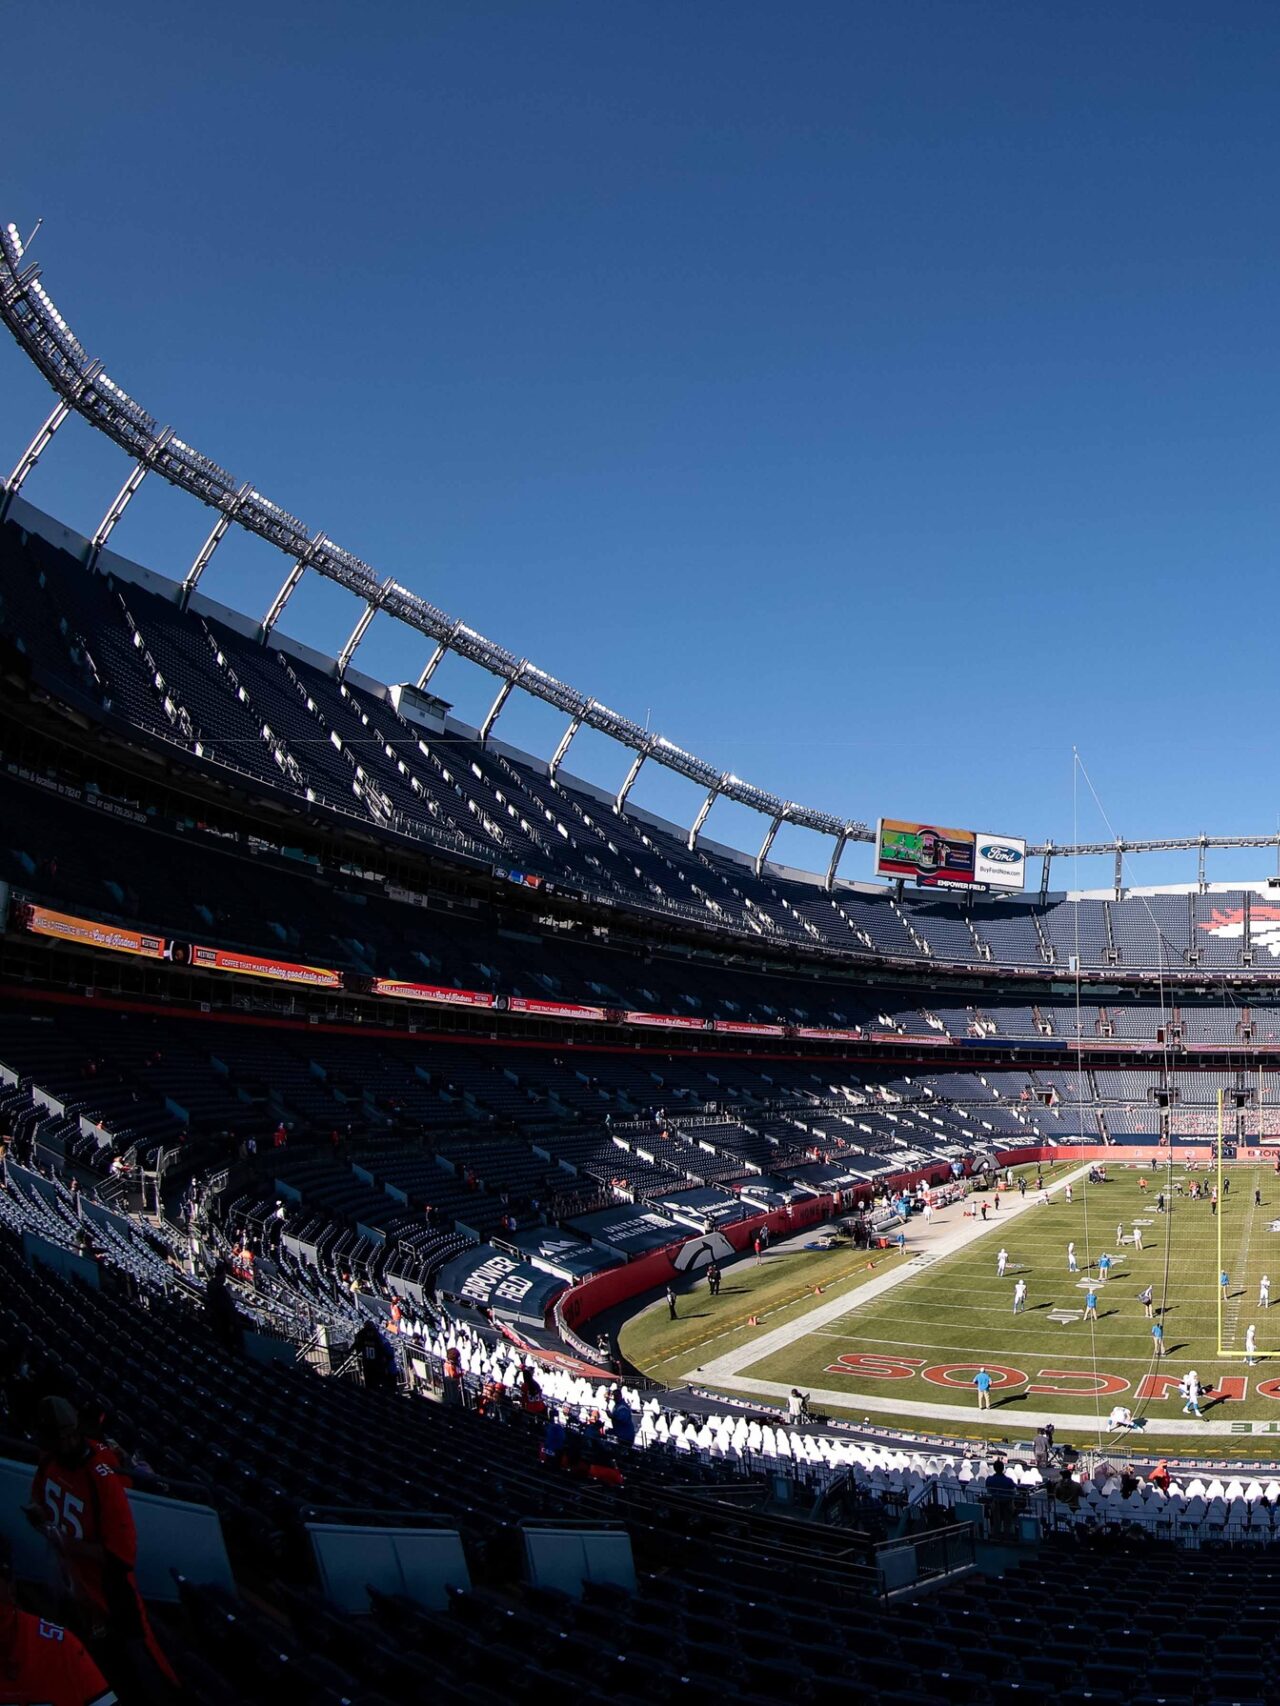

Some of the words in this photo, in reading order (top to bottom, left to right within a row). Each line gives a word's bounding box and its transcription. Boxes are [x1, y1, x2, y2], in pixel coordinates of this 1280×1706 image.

[986, 846, 1016, 862] Ford
[937, 879, 969, 890] EMPOWER
[969, 883, 987, 892] FIELD
[222, 958, 239, 968] COFFEE
[239, 961, 252, 970] THAT
[268, 966, 286, 980] doing
[286, 970, 302, 982] good
[603, 1218, 645, 1233] UNITED
[607, 1223, 658, 1242] AIRLINES
[461, 1256, 520, 1302] EMPOWER
[495, 1275, 533, 1302] FIELD
[45, 1477, 84, 1541] 55
